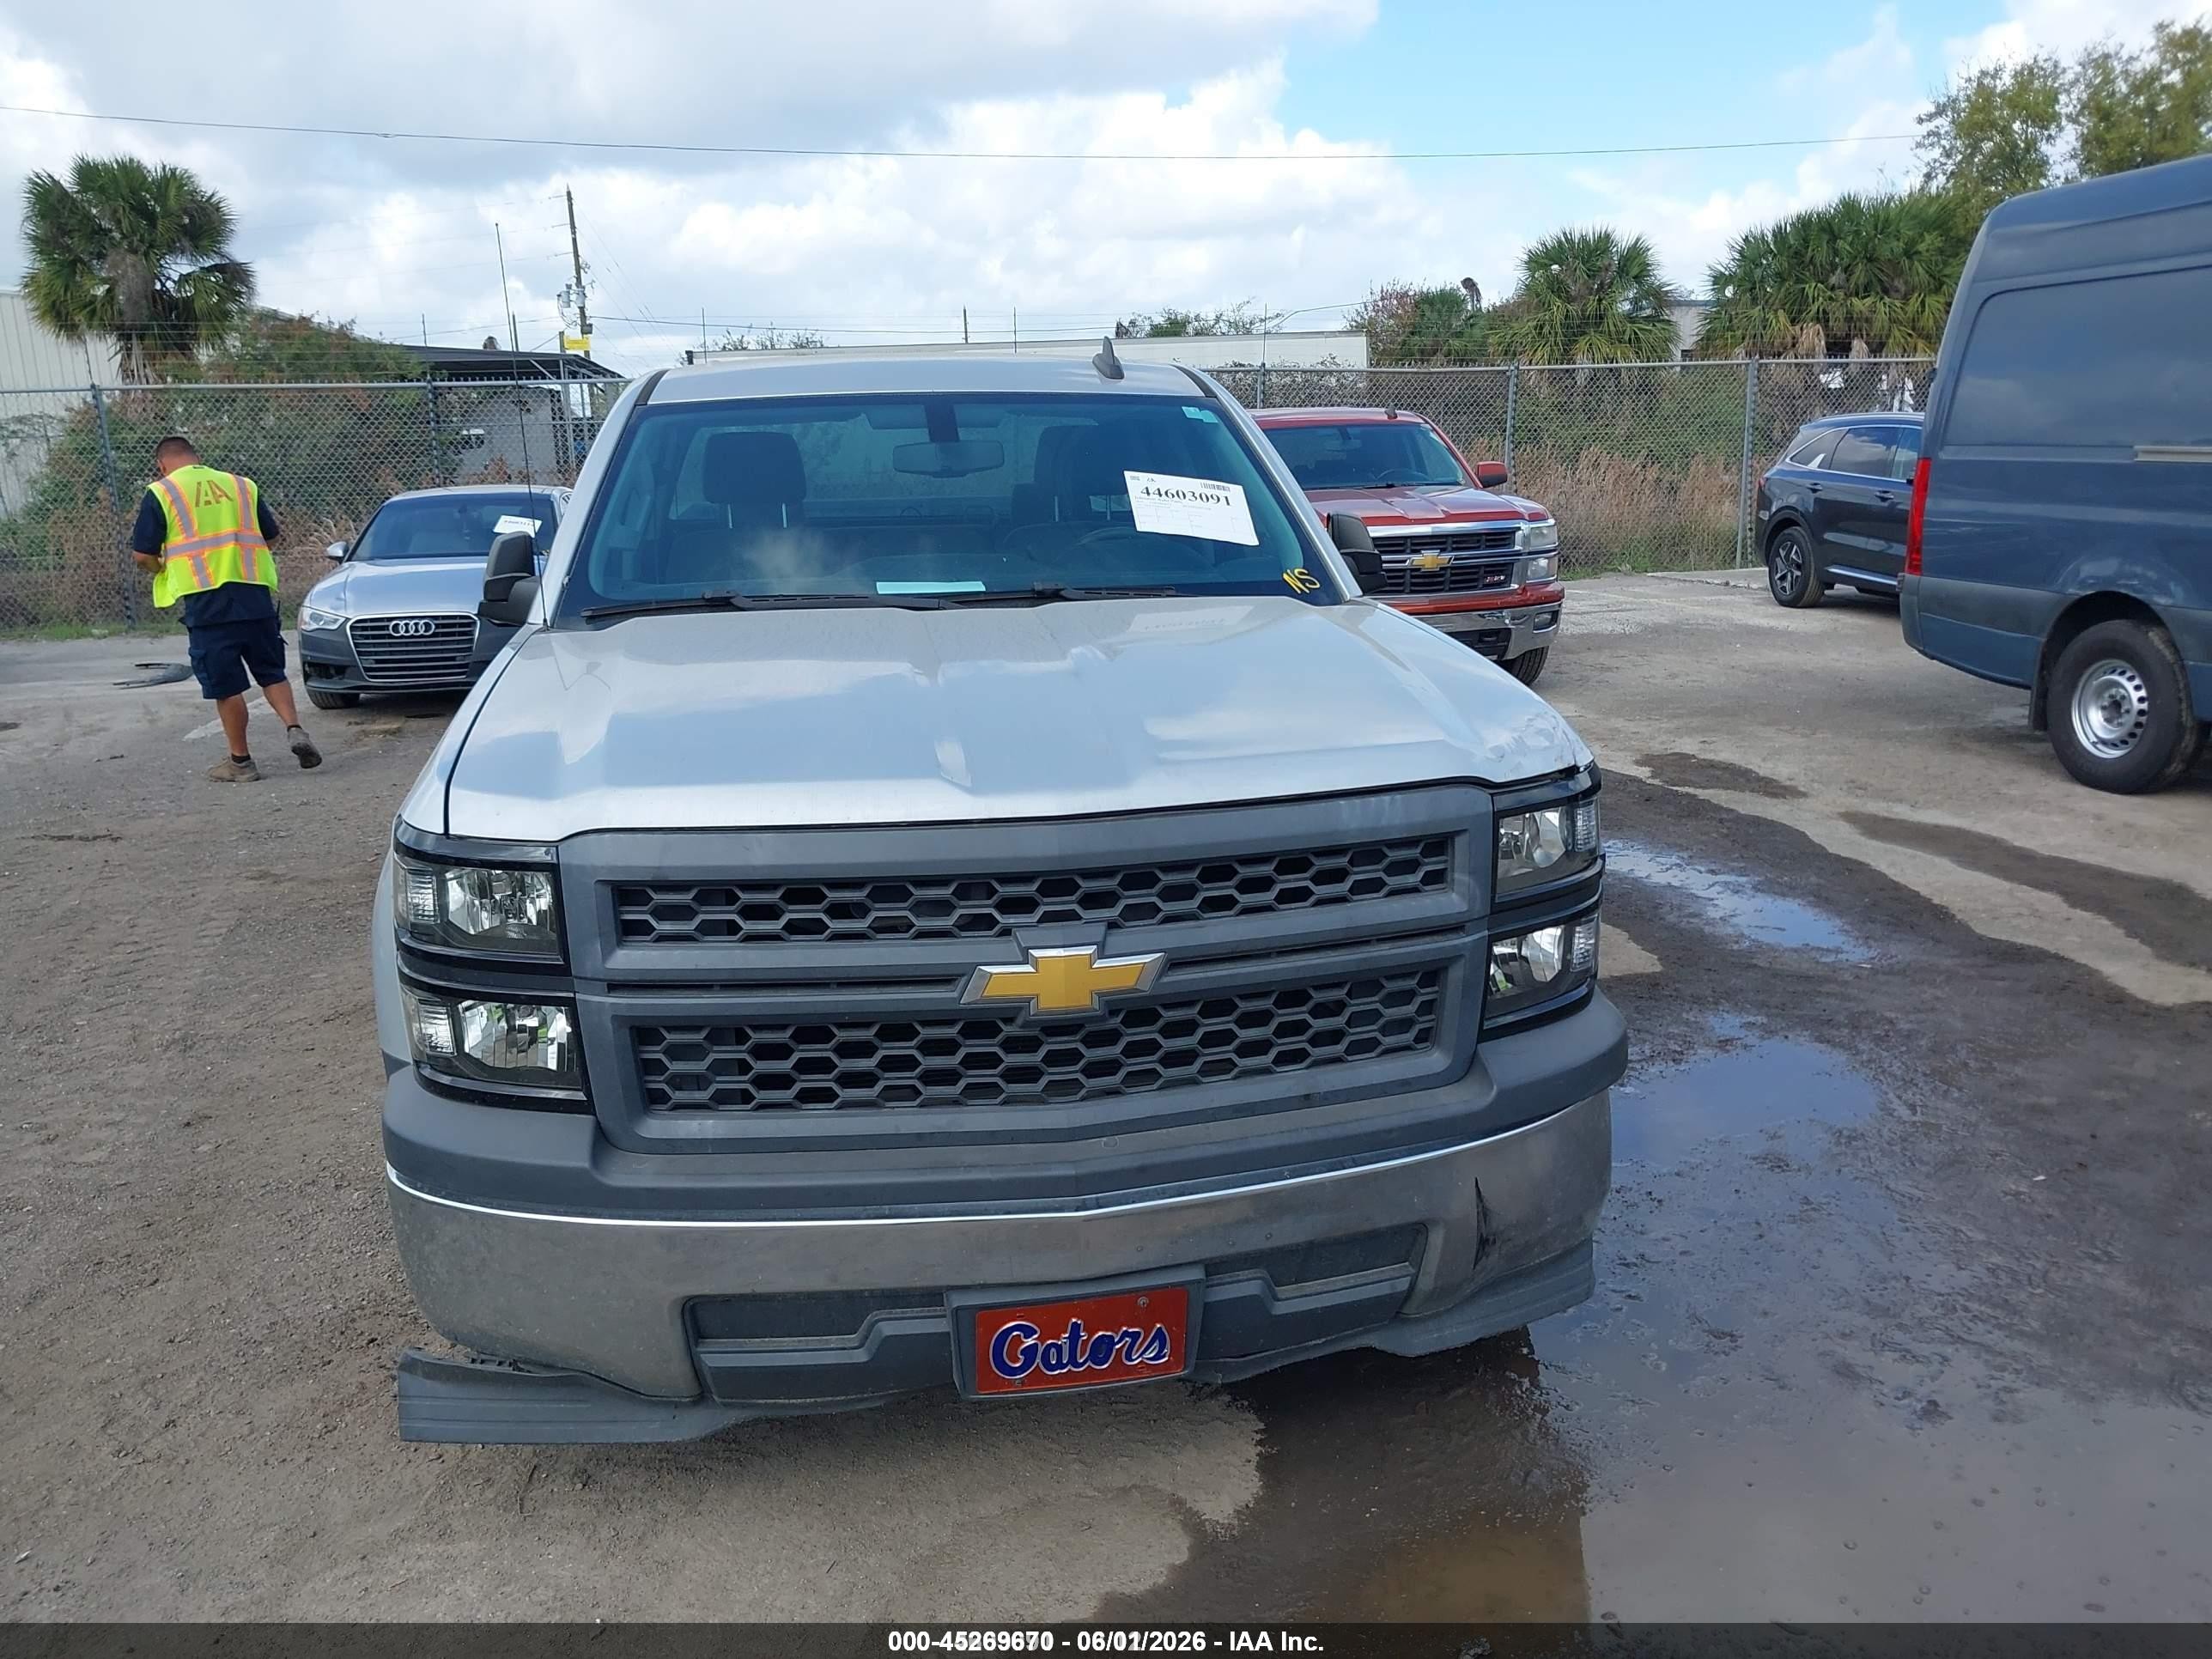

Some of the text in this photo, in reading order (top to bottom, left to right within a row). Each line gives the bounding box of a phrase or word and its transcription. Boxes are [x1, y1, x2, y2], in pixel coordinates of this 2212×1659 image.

[1140, 485, 1231, 507] 44603091
[1283, 568, 1321, 593] NS
[989, 1317, 1171, 1379] Gators
